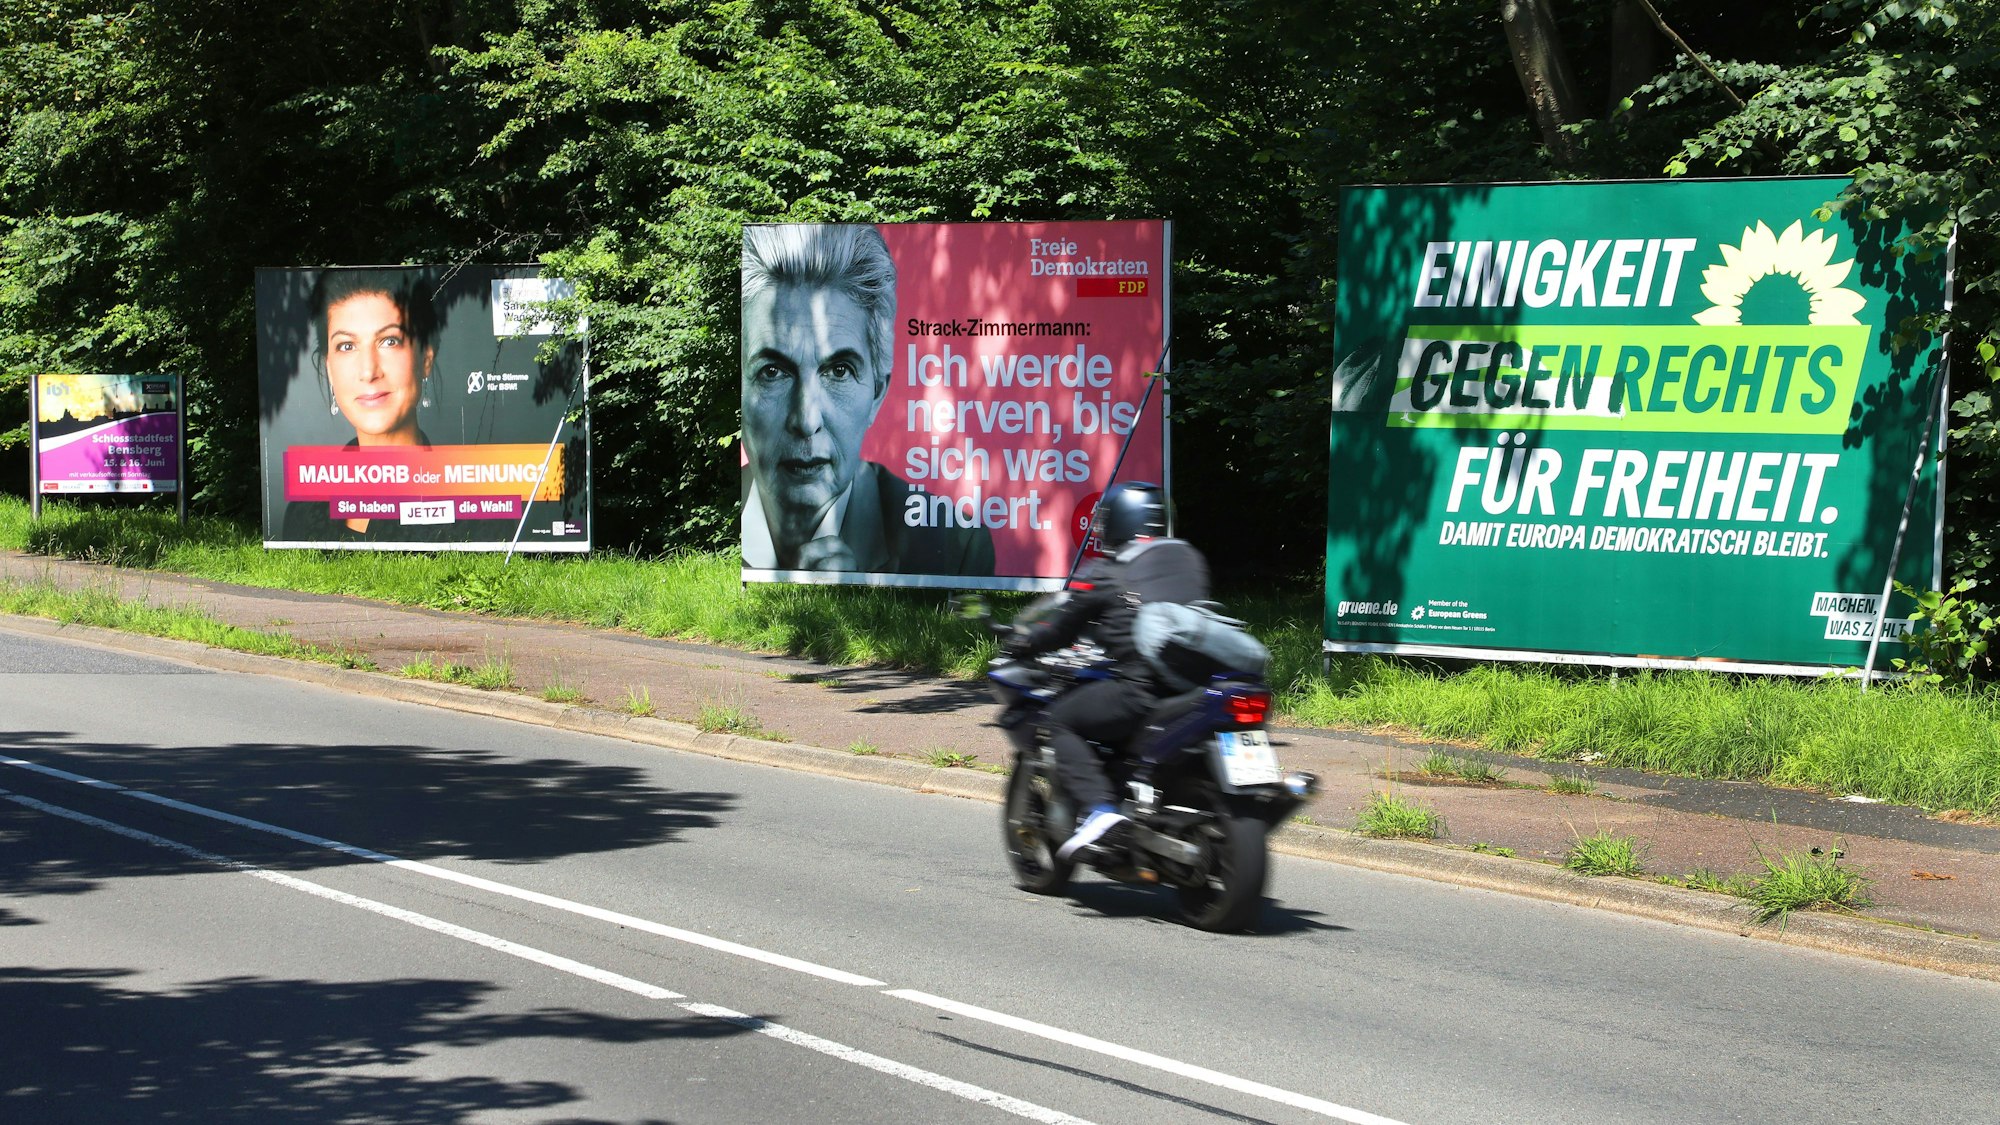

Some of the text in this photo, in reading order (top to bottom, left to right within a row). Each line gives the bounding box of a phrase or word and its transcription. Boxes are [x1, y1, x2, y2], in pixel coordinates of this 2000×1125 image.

[1030, 237, 1078, 256] Freie
[1030, 256, 1148, 276] Demokraten
[1413, 238, 1697, 308] EINIGKEIT
[1118, 281, 1146, 294] FDP
[907, 318, 1091, 337] Strack-Zimmermann:
[907, 344, 1113, 388] Ich werde
[486, 373, 501, 381] Ihre
[1410, 340, 1843, 414] GEGEN RECHTS
[907, 391, 1136, 444] nerven, bis
[92, 434, 174, 443] Schlossstadtfest
[108, 445, 162, 456] Bensberg
[905, 436, 1090, 482] sich was
[103, 458, 165, 467] 15. & 16. Juni
[299, 464, 548, 484] MAULKORB oder MEINUNG?
[1446, 431, 1840, 525] FÜR FREIHEIT.
[337, 500, 513, 519] Sie haben JETZT die Wahl!
[904, 484, 1053, 530] ändert.
[1438, 521, 1829, 559] DAMIT EUROPA DEMOKRATISCH BLEIBT.
[1337, 600, 1398, 618] gruene.de
[1452, 600, 1458, 608] of
[1815, 596, 1878, 615] MACHEN,
[1428, 609, 1487, 620] European Greens
[1830, 620, 1907, 638] WAS ZHLT
